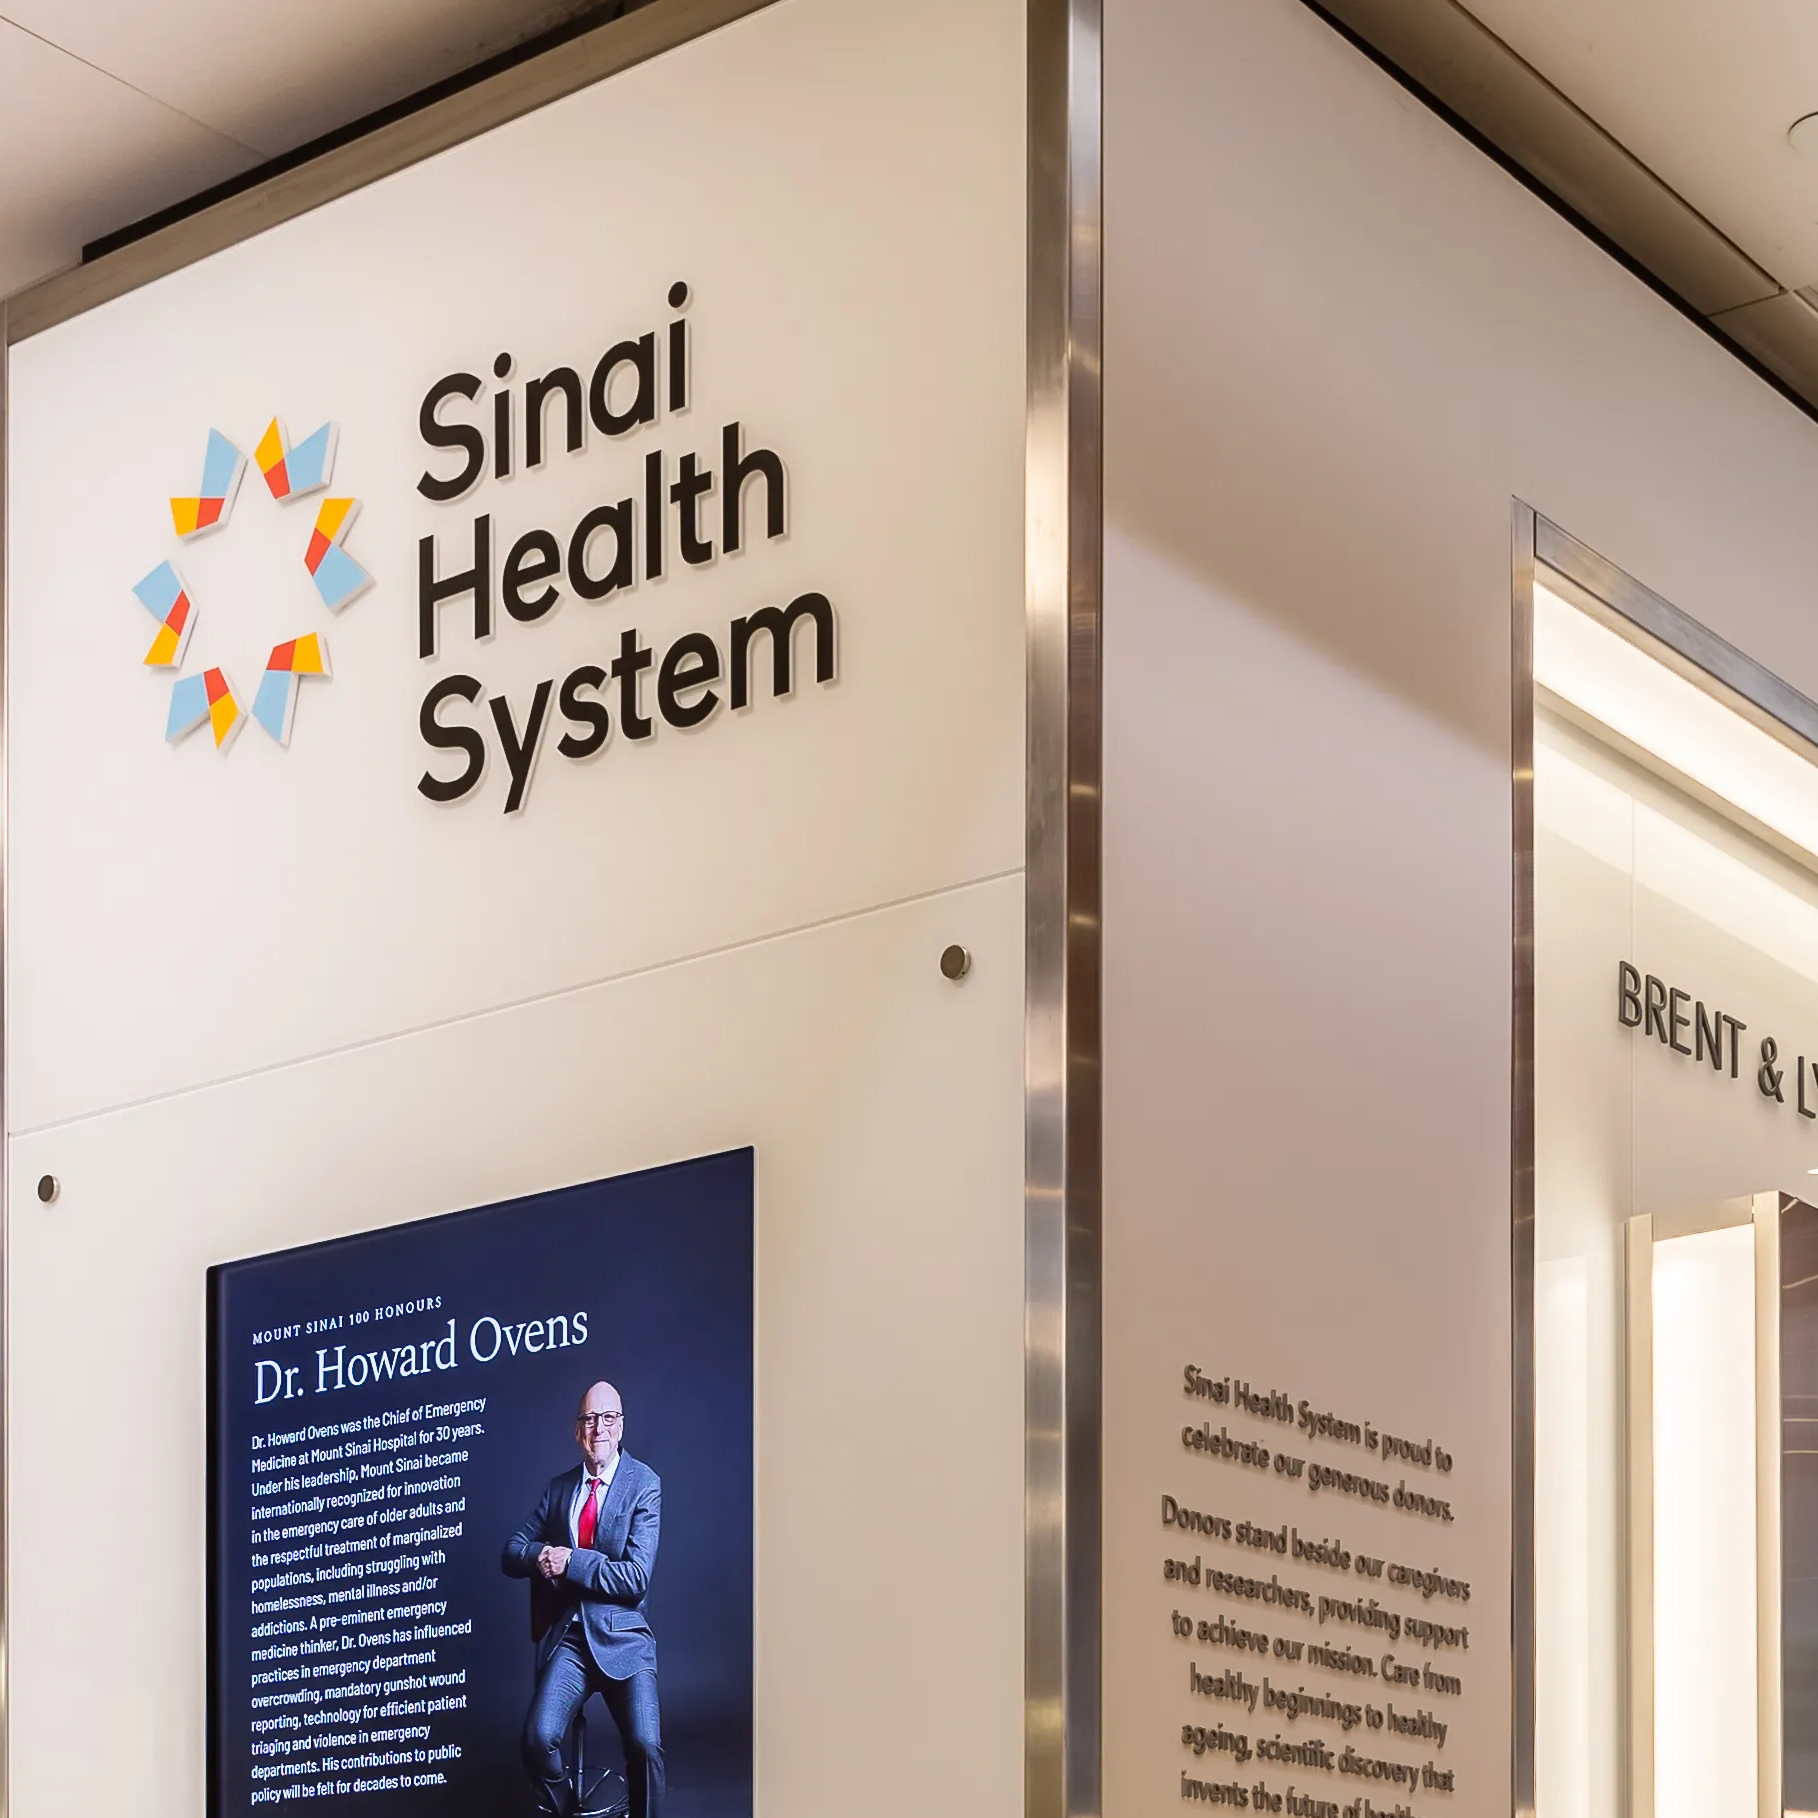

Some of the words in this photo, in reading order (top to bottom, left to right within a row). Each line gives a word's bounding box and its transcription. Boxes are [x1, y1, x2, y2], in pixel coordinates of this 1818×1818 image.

[416, 281, 689, 501] Sinai
[418, 421, 785, 658] Health
[416, 592, 836, 815] System
[1618, 961, 1746, 1078] BRENT
[1756, 1036, 1785, 1103] &
[253, 1325, 300, 1345] MOUNT
[306, 1316, 343, 1334] SINAI
[349, 1311, 369, 1325] 100
[375, 1296, 441, 1320] HONOURS
[255, 1361, 303, 1404] Dr.
[315, 1320, 458, 1392] Howard
[470, 1312, 587, 1361] Ovens
[252, 1436, 266, 1449] Dr.
[268, 1427, 306, 1447] Howard
[308, 1425, 339, 1439] Ovens
[341, 1421, 361, 1433] was
[363, 1416, 380, 1429] the
[383, 1408, 410, 1426] Chief
[412, 1406, 423, 1420] of
[426, 1398, 486, 1418] Emergency
[252, 1455, 296, 1473] Medicine
[299, 1452, 309, 1465] at
[311, 1446, 343, 1463] Mount
[345, 1439, 371, 1457] Sinai
[373, 1431, 416, 1452] Hospital
[419, 1430, 434, 1444] for
[436, 1426, 450, 1441] 30
[452, 1424, 484, 1442] years.
[1184, 1364, 1229, 1403] Sinai
[1235, 1379, 1294, 1422] Health
[1298, 1400, 1361, 1442] System
[1365, 1420, 1378, 1450] is
[1382, 1433, 1431, 1466] proud
[1435, 1445, 1452, 1472] to
[252, 1481, 283, 1496] Under
[285, 1477, 300, 1491] his
[302, 1468, 358, 1488] leadership,
[361, 1461, 394, 1478] Mount
[396, 1455, 422, 1472] Sinai
[425, 1451, 468, 1467] became
[252, 1497, 325, 1520] internationally
[327, 1486, 384, 1508] recognized
[387, 1484, 402, 1498] for
[405, 1475, 460, 1495] innovation
[1182, 1422, 1270, 1468] celebrate
[1274, 1452, 1305, 1477] our
[1308, 1463, 1389, 1502] generous
[1393, 1479, 1454, 1520] donors.
[1162, 1494, 1231, 1539] Donors
[1236, 1520, 1287, 1554] stand
[1292, 1527, 1351, 1569] beside
[1355, 1554, 1385, 1577] our
[1388, 1563, 1470, 1600] caregivers
[1164, 1554, 1200, 1585] and
[1206, 1568, 1314, 1614] researchers,
[1319, 1596, 1400, 1639] providing
[1405, 1617, 1469, 1648] support
